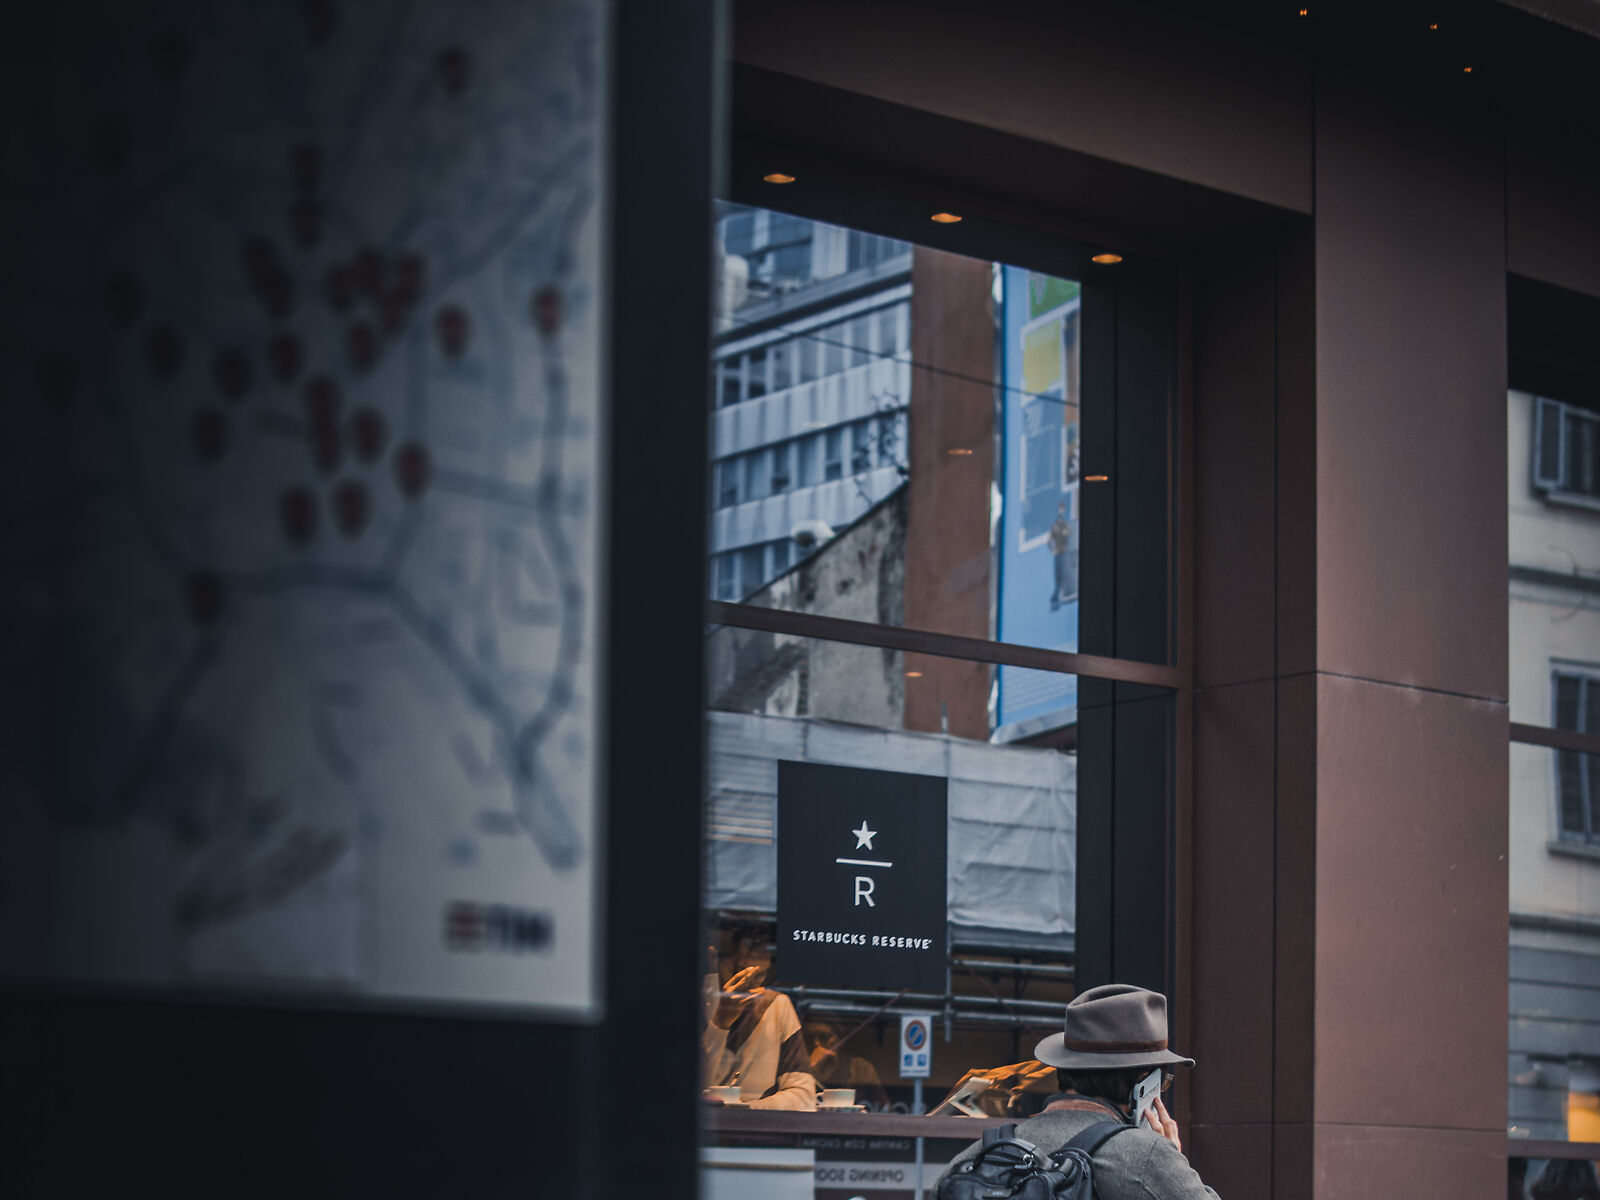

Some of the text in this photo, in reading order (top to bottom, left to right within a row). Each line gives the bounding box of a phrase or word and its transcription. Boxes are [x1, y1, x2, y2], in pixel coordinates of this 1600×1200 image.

[855, 876, 876, 907] R
[792, 929, 930, 951] STARBUCKS RESERVE
